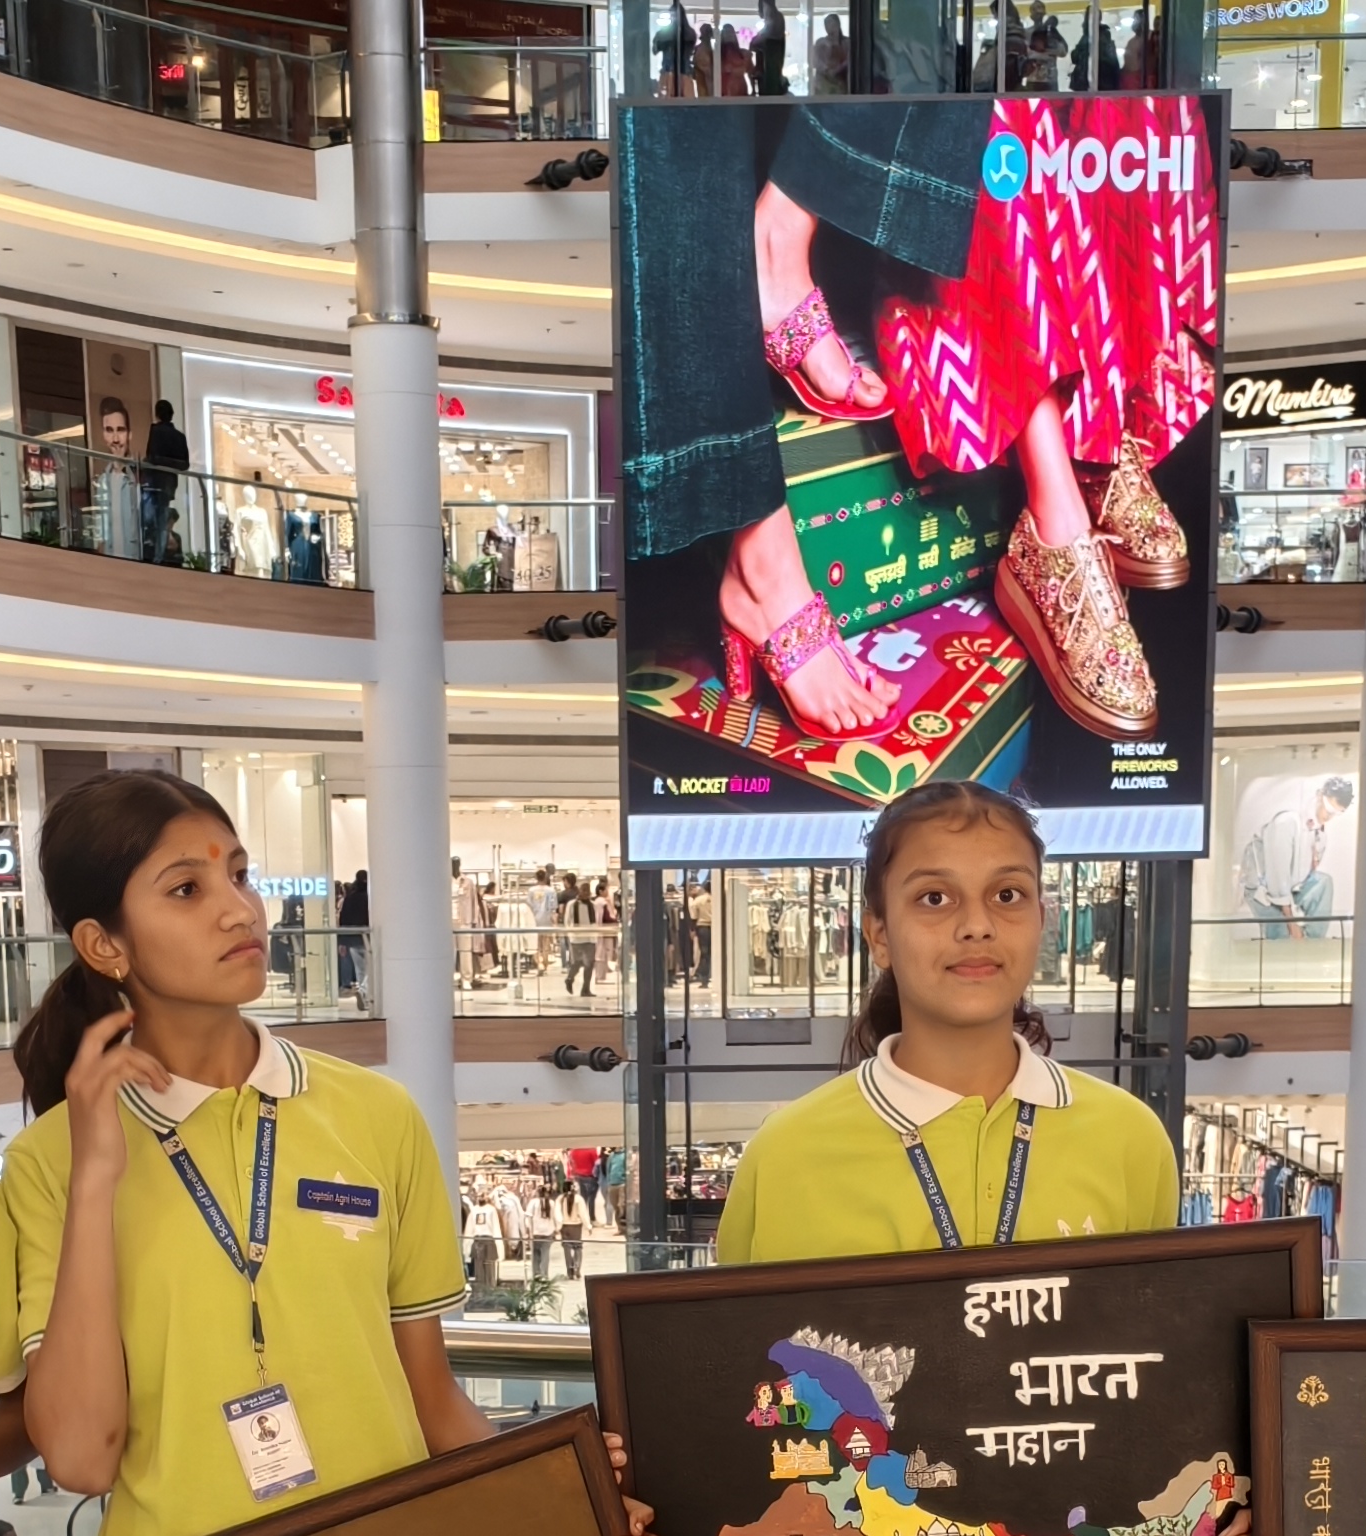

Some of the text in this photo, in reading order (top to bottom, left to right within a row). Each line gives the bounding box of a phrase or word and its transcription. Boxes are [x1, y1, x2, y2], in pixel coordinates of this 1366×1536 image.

[1031, 135, 1195, 194] MOCHI
[1223, 377, 1356, 418] Mumkins
[1111, 742, 1167, 756] THE ONLY
[1111, 759, 1178, 773] FIREWORKS
[680, 778, 728, 794] ROCKET
[255, 1122, 272, 1239] Global School of Excellence
[1010, 1142, 1024, 1188] Excellence
[307, 1189, 372, 1207] Captain Agni House
[1000, 1200, 1014, 1232] School
[1008, 1189, 1017, 1200] of
[964, 1276, 1069, 1337] हमारा
[1010, 1353, 1164, 1406] भारत
[965, 1422, 1095, 1467] महान
[1305, 1456, 1332, 1512] भारत
